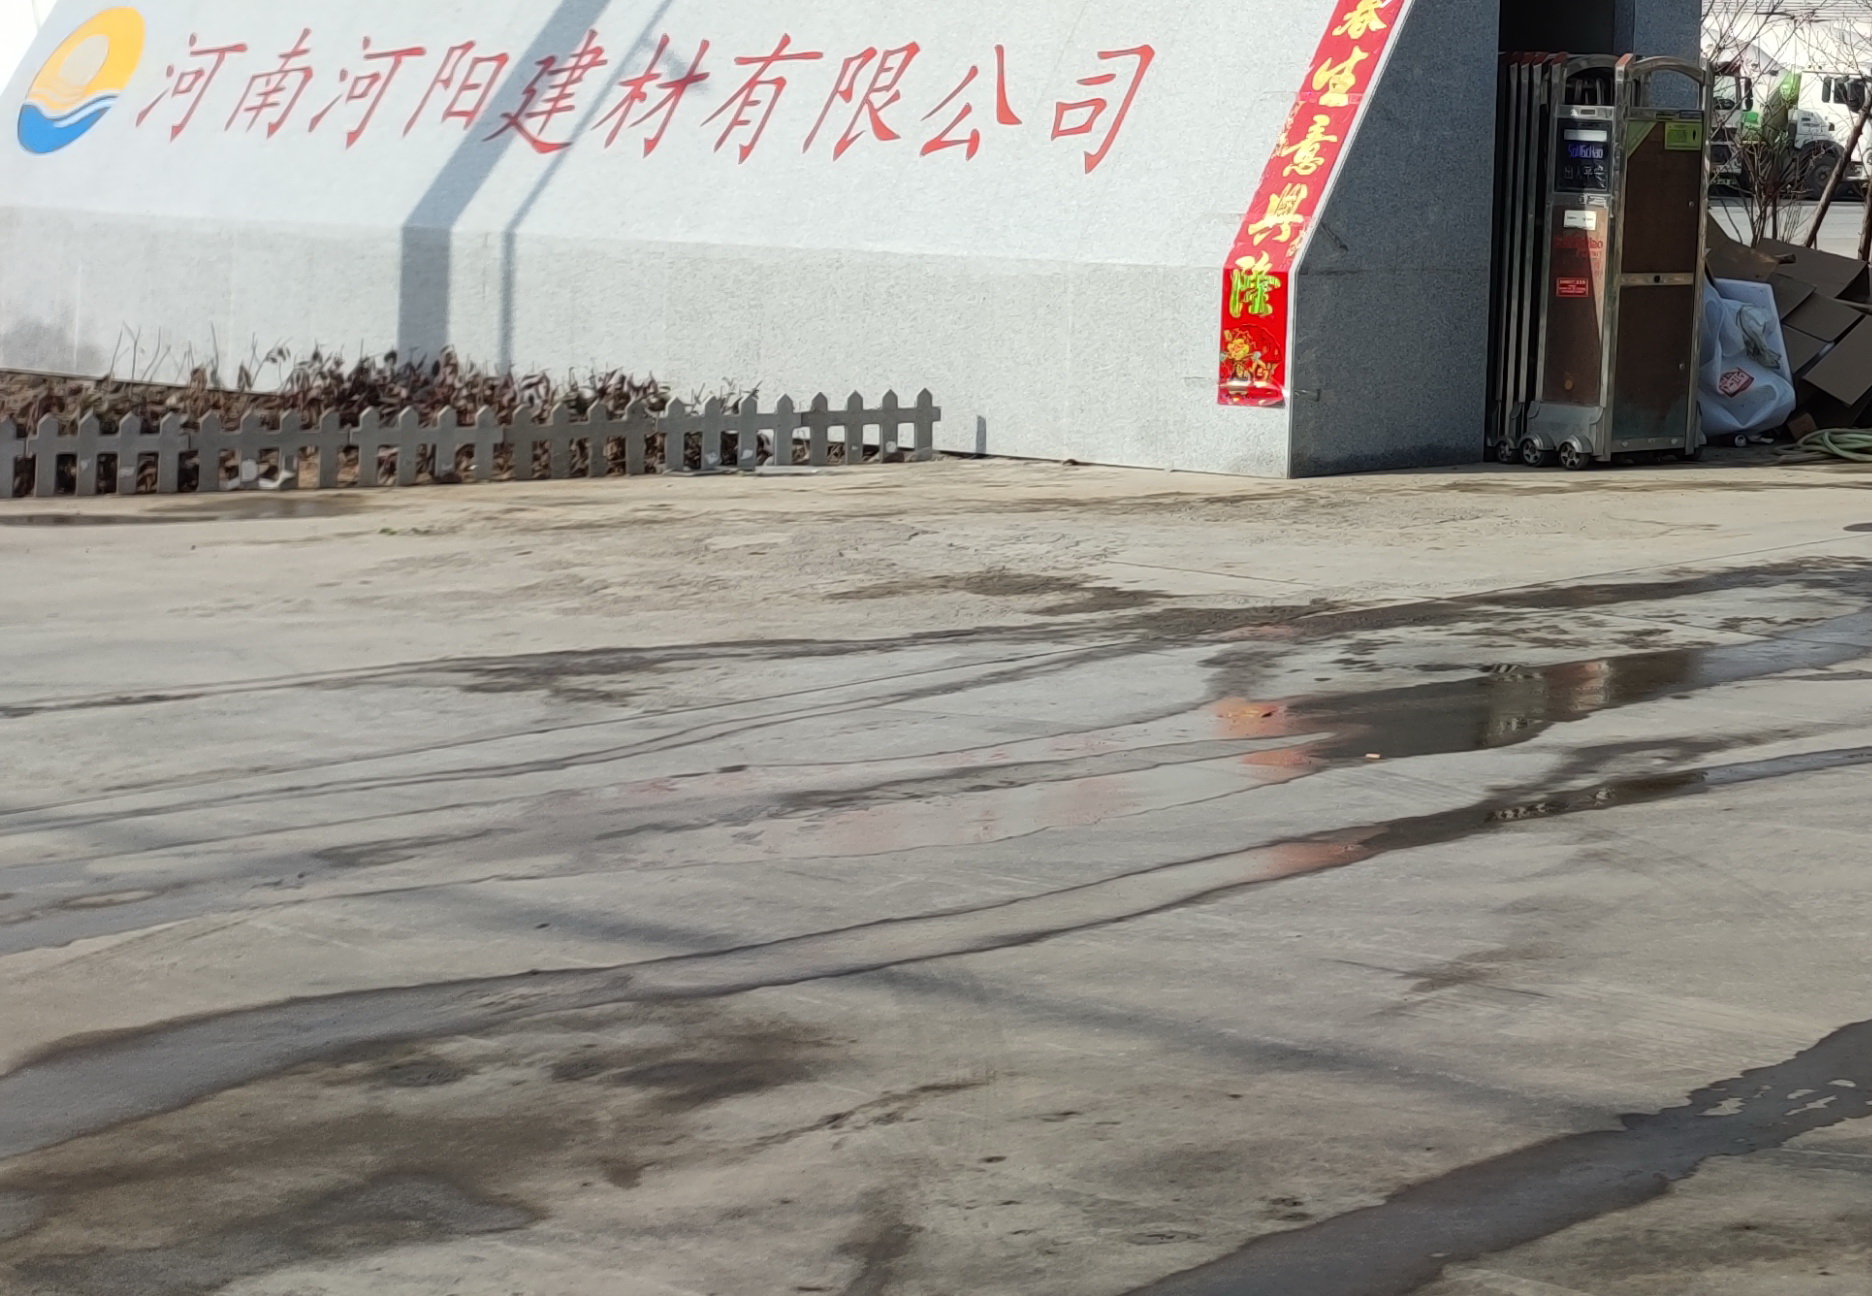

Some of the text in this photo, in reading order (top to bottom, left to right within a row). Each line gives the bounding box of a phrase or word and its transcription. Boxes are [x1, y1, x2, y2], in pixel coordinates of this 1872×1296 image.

[135, 26, 1157, 175] 河南河阳建材有限公司
